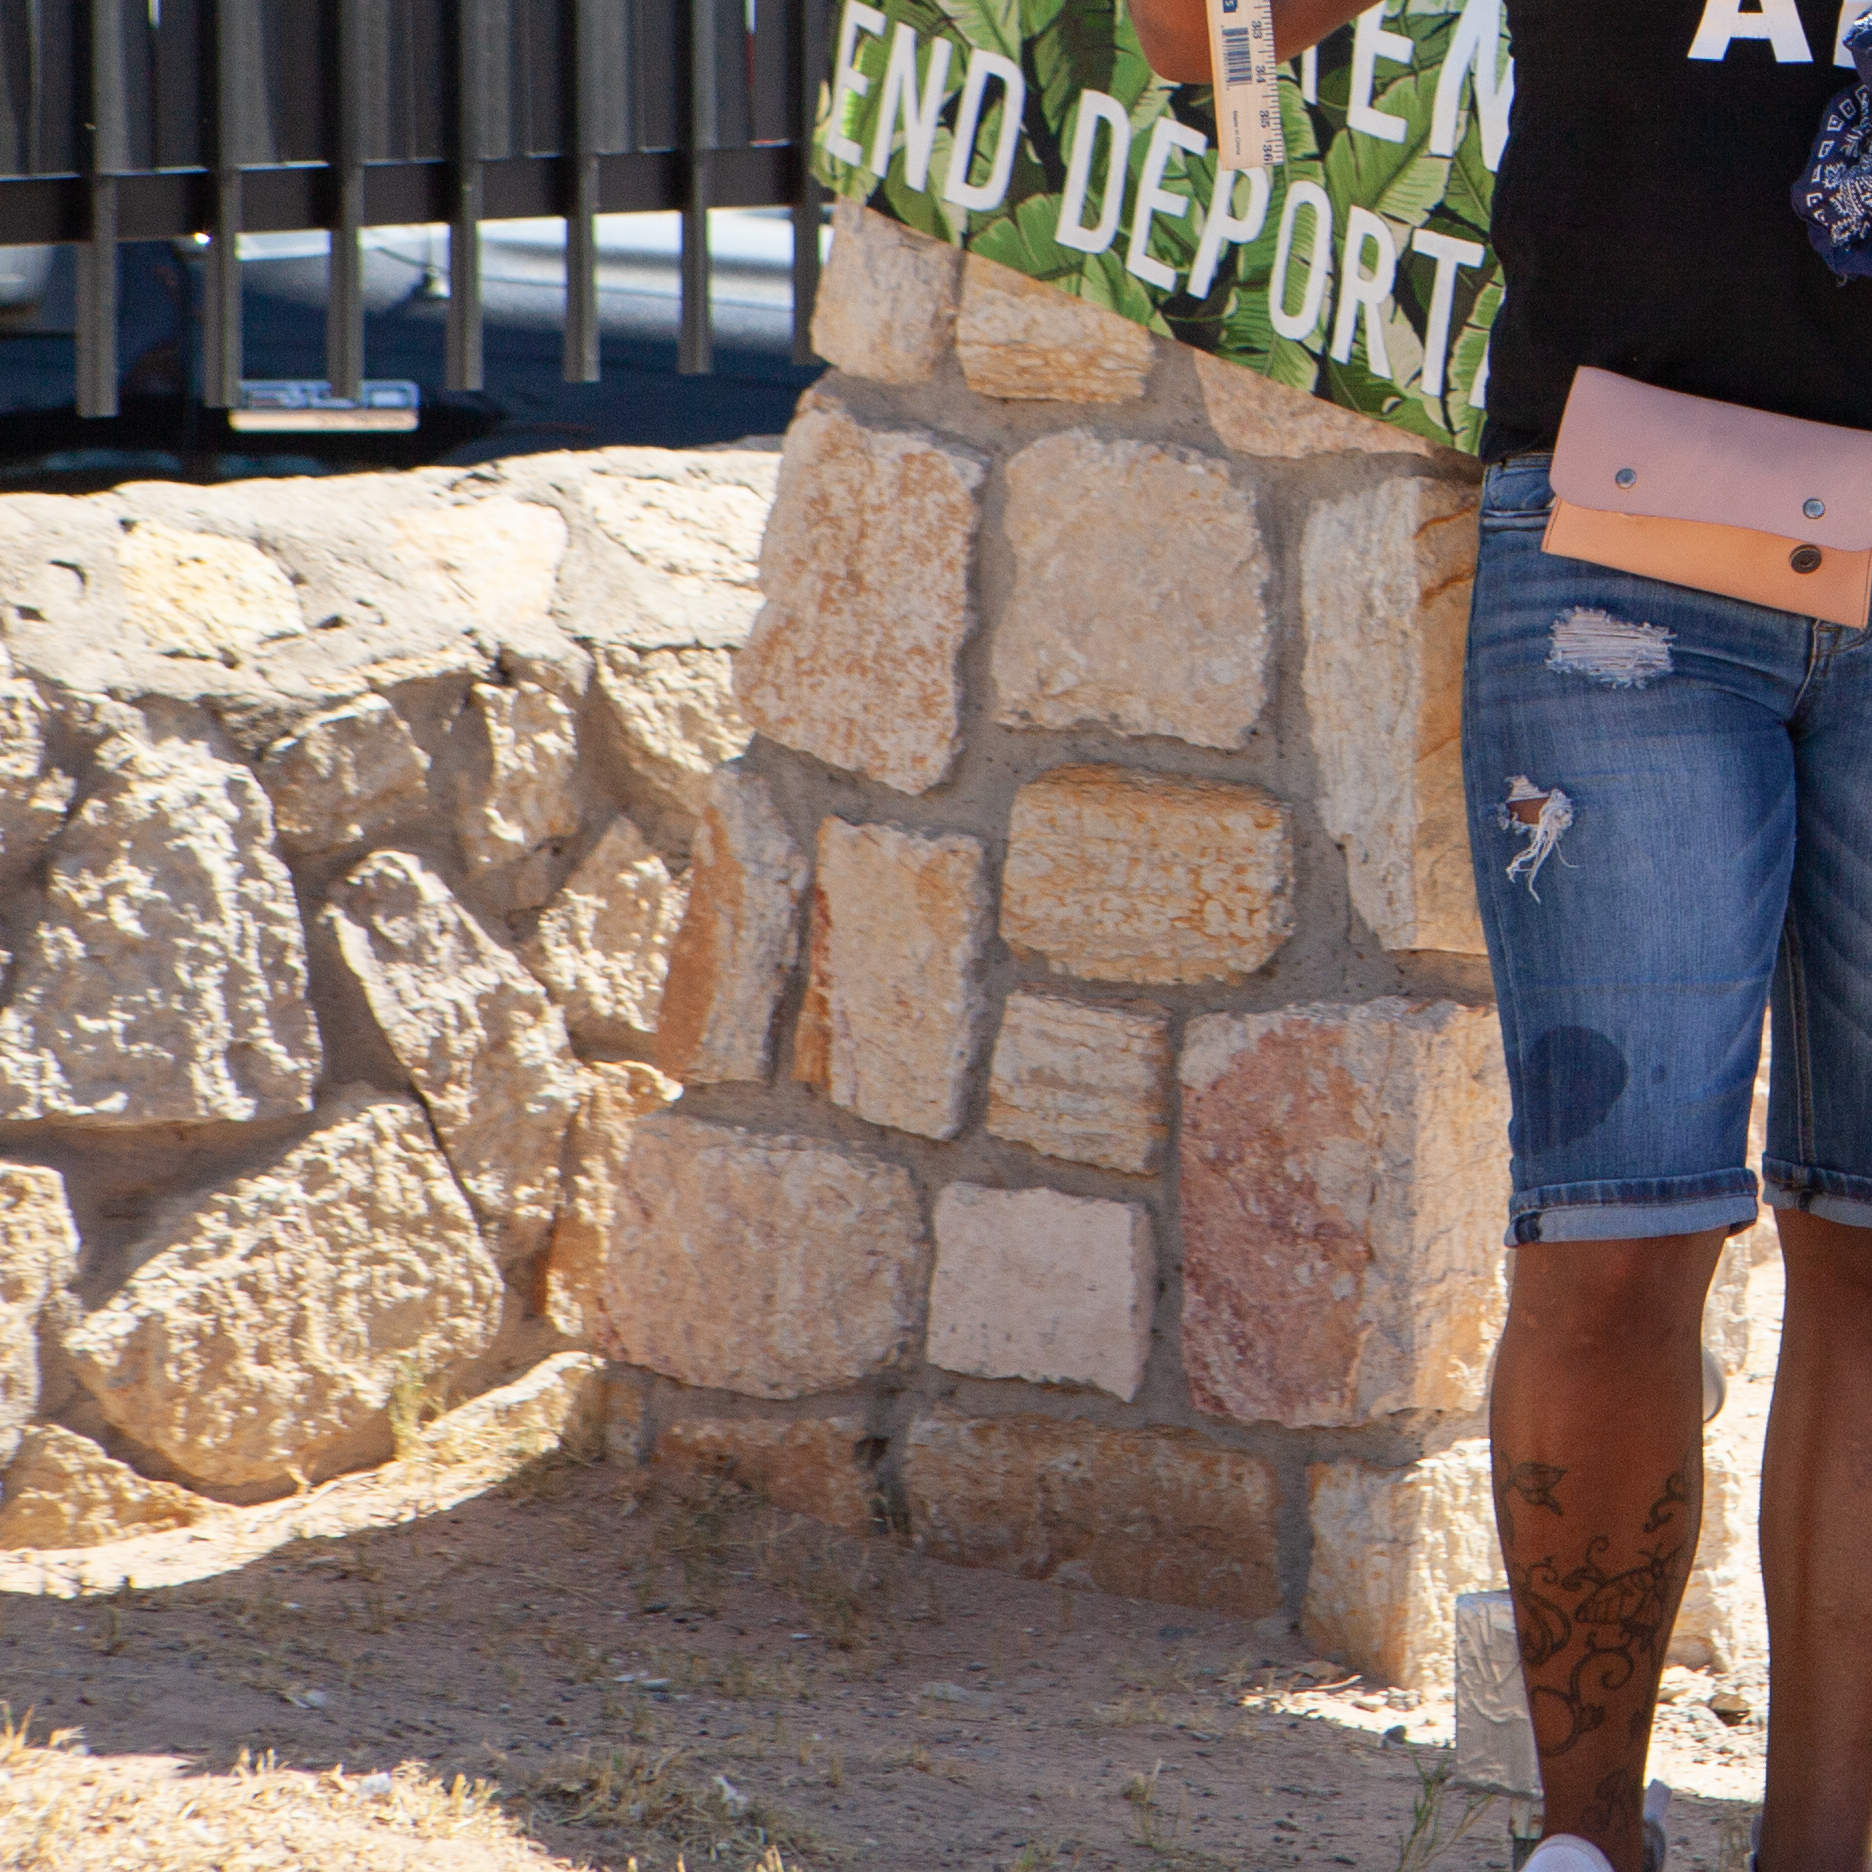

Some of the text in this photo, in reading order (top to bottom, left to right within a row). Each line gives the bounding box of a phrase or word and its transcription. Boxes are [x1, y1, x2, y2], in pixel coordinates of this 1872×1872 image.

[1251, 20, 1263, 39] 33
[1255, 64, 1267, 84] 34
[1259, 109, 1271, 129] 35
[1263, 144, 1274, 162] 36
[1057, 88, 1506, 410] DEPORT
